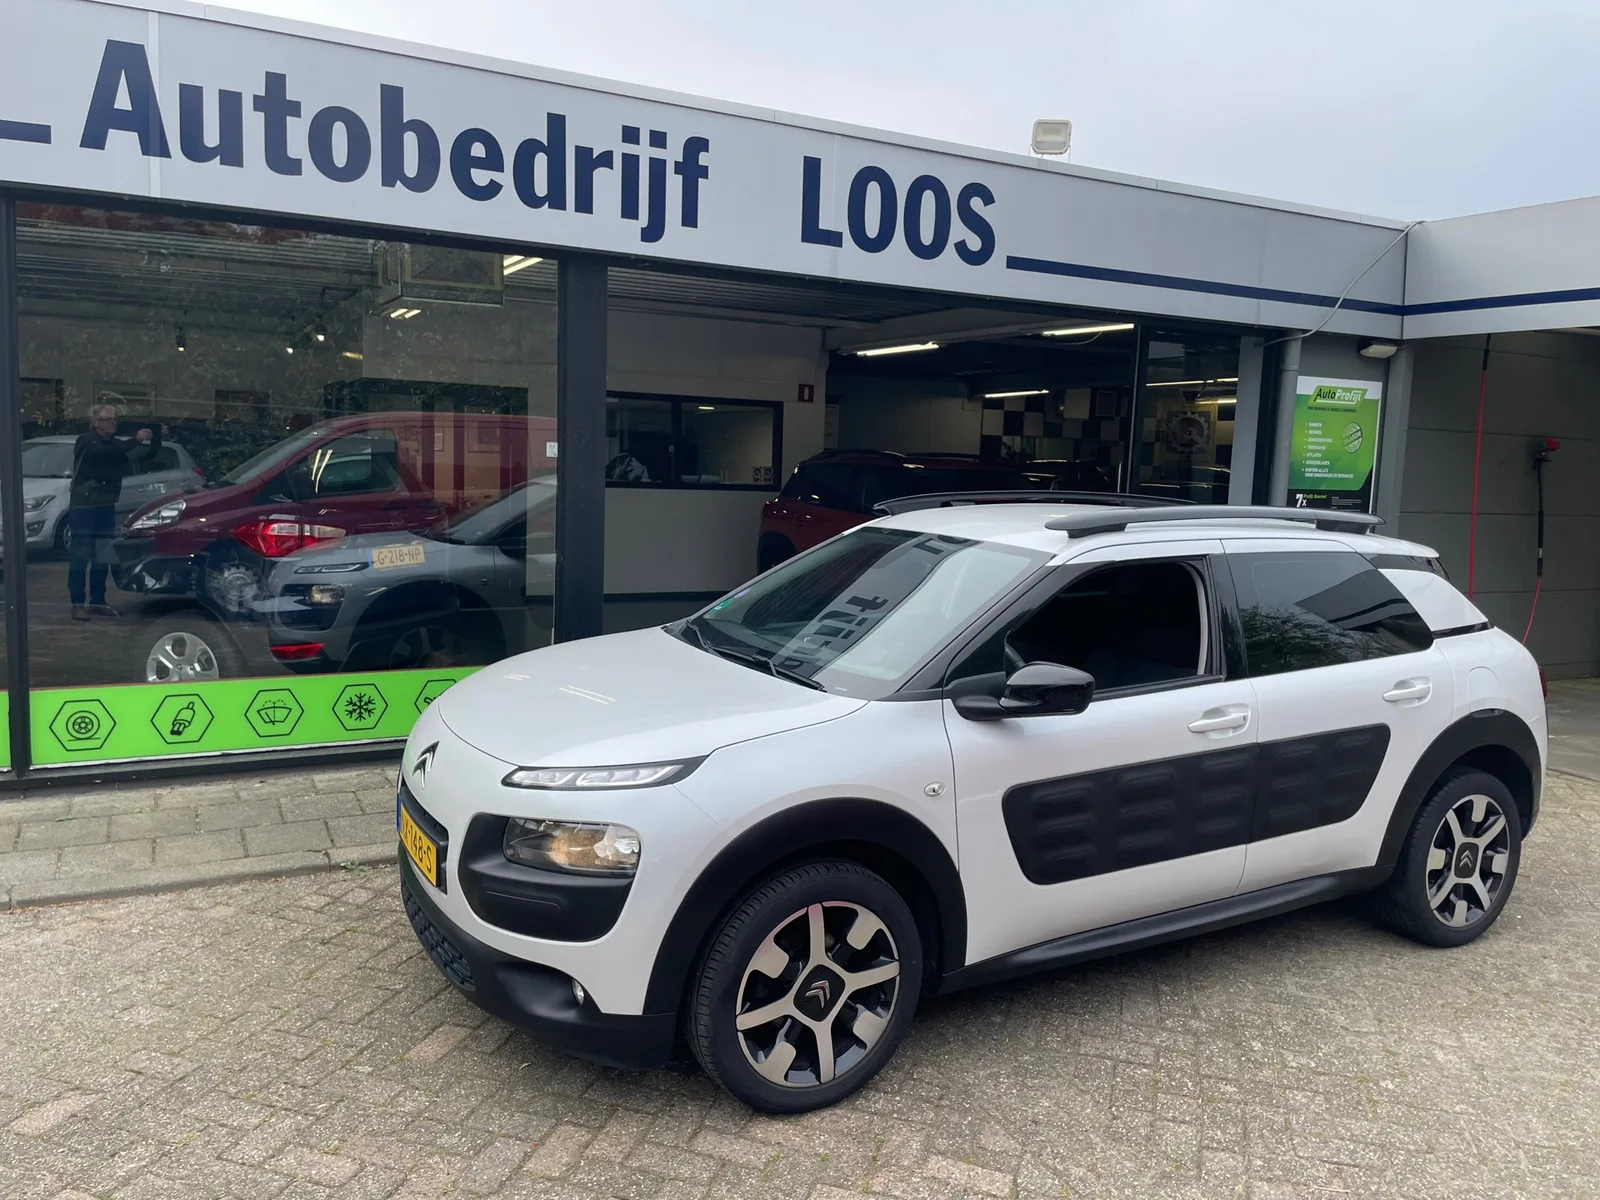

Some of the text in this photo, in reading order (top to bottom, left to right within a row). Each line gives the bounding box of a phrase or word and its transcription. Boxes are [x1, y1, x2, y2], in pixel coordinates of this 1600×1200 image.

[79, 39, 996, 266] Autobedrijf LOOS
[377, 548, 420, 565] G-218-NP
